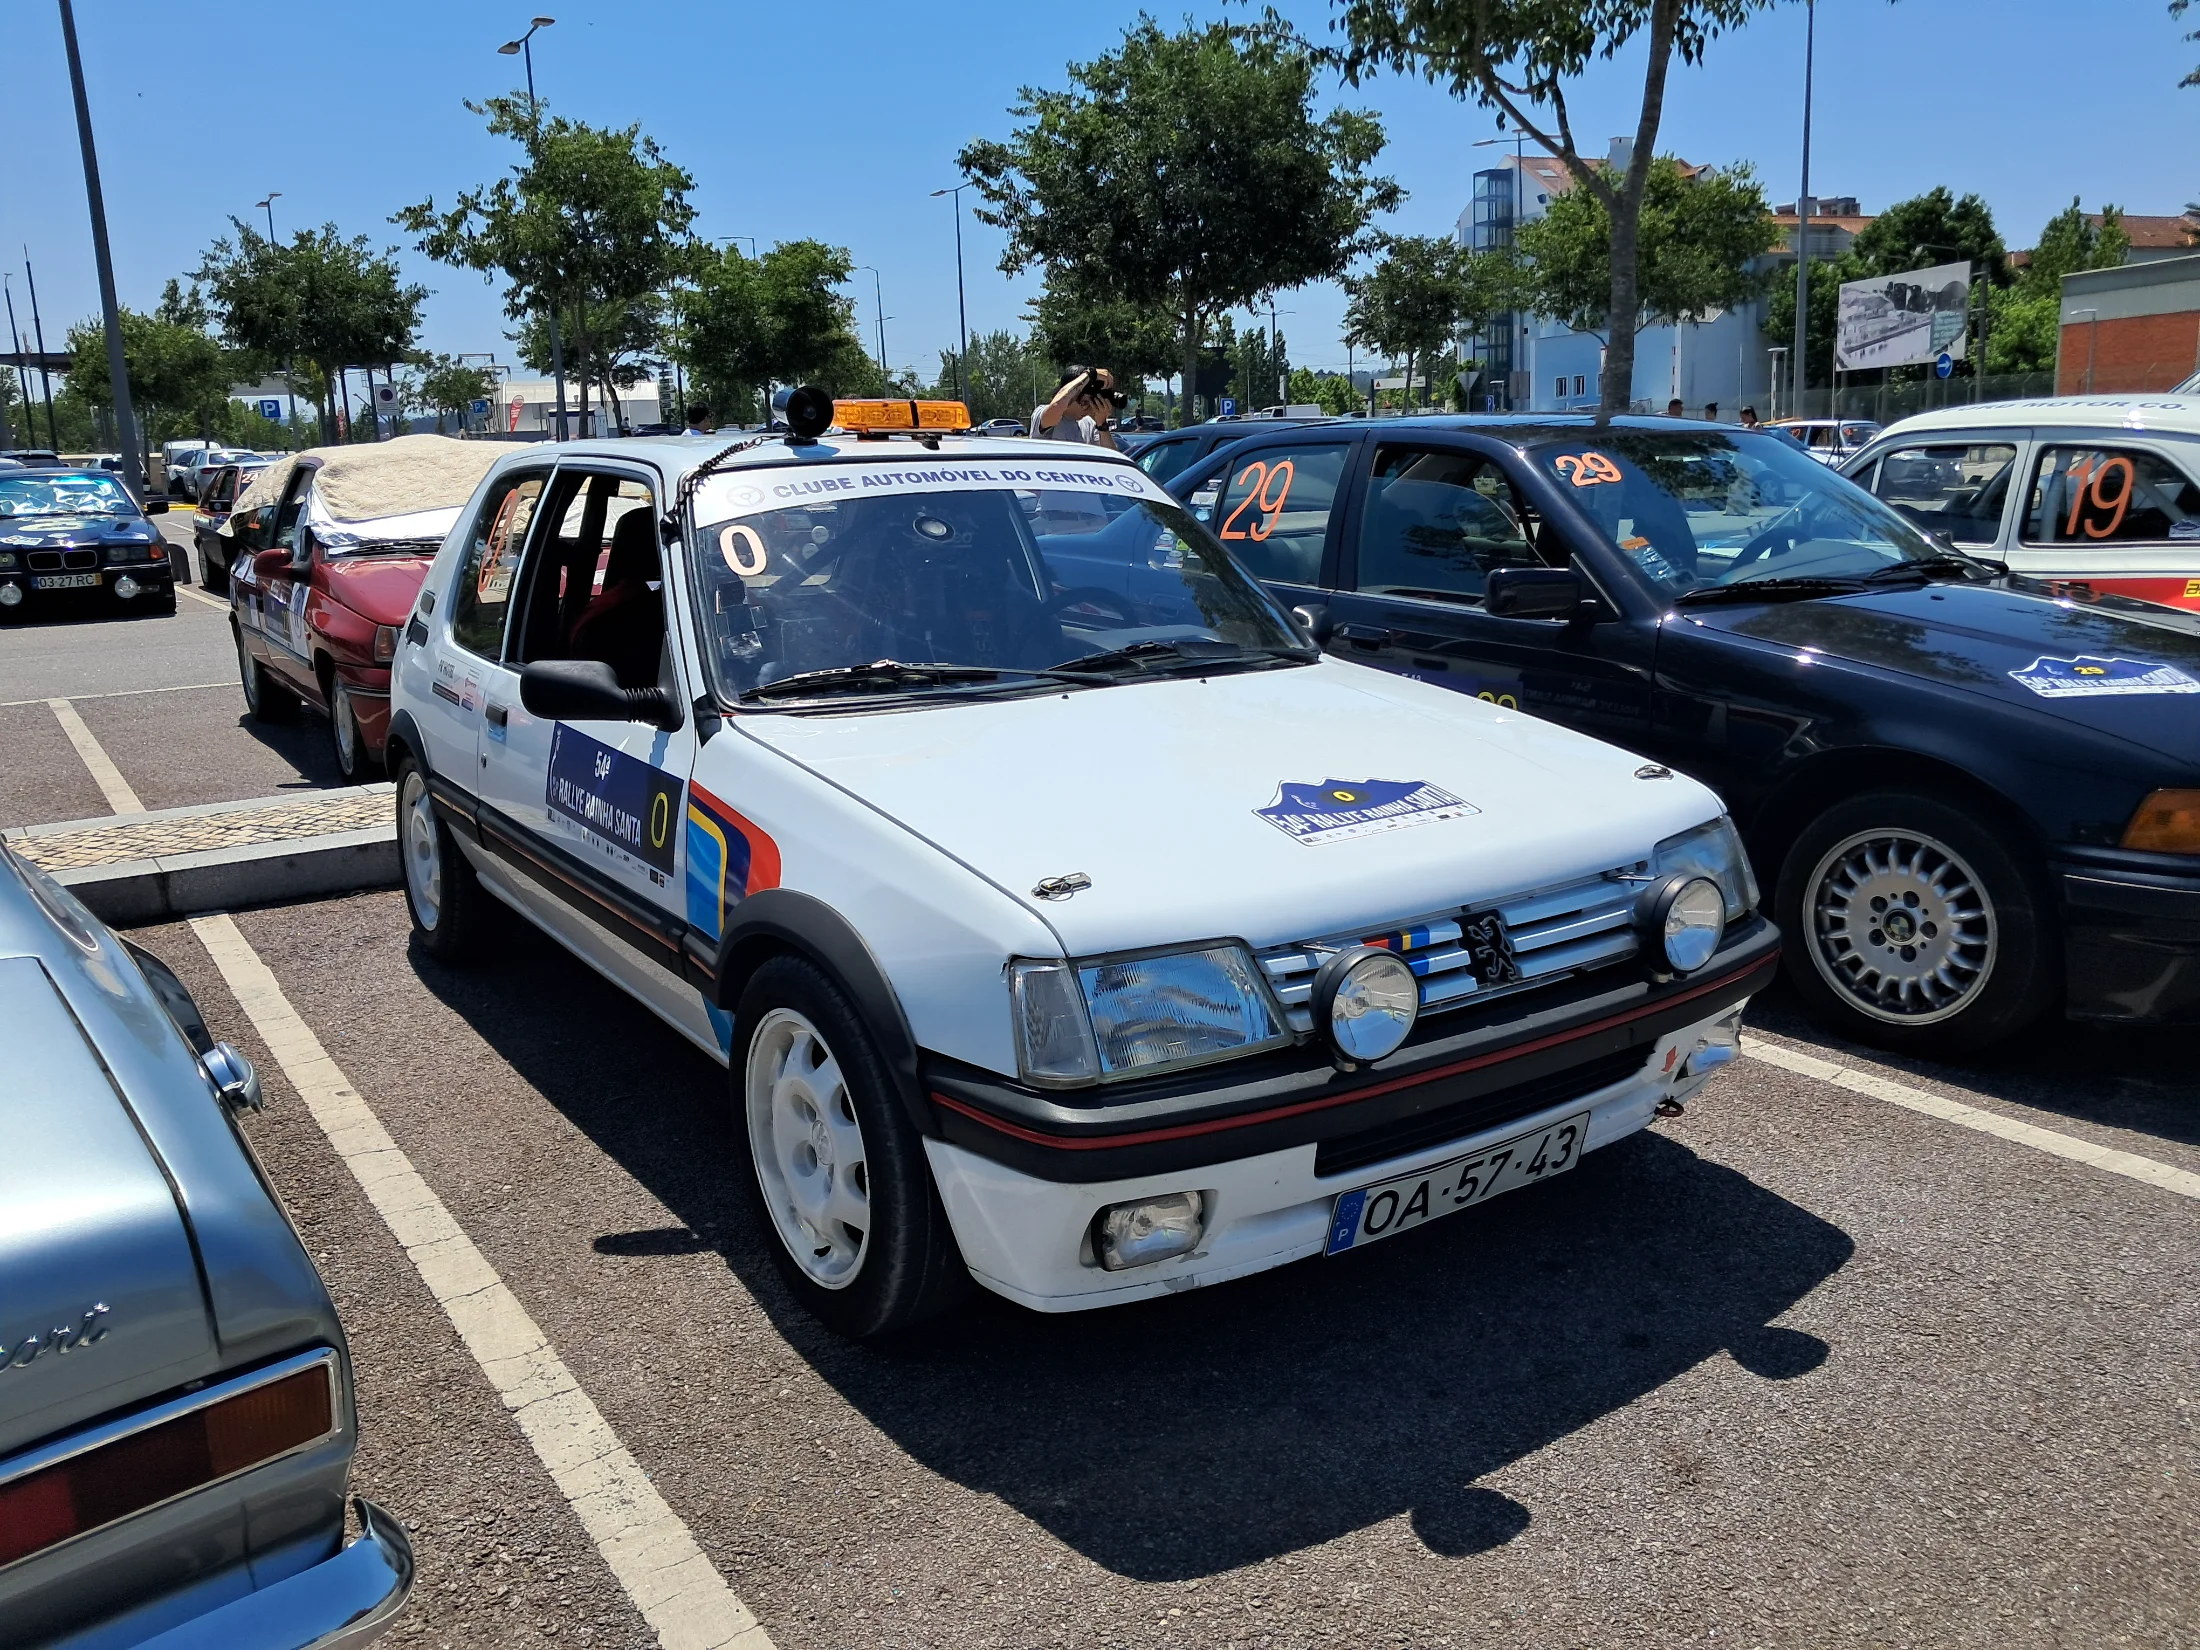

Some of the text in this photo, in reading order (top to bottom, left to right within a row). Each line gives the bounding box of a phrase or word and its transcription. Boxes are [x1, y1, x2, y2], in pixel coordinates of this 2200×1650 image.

[264, 400, 276, 416] P
[1224, 400, 1233, 414] P
[2021, 400, 2131, 409] MOTOR
[2138, 401, 2188, 411] CO.
[772, 468, 1114, 499] CLUBE AUTOMÓVEL DO CENTRO
[1555, 452, 1623, 487] 29
[1220, 461, 1294, 541] 29
[2066, 457, 2135, 538] 19
[719, 524, 768, 577] 0
[2073, 666, 2105, 675] 29
[558, 777, 585, 815] RALLYE
[584, 791, 613, 830] RAINHA
[614, 808, 642, 847] SANTA
[1302, 811, 1366, 830] RALLYE
[1361, 799, 1413, 820] RAINHA
[1404, 786, 1464, 810] SANTA
[1332, 791, 1355, 802] 0
[651, 791, 669, 848] 0
[1338, 1228, 1349, 1242] P
